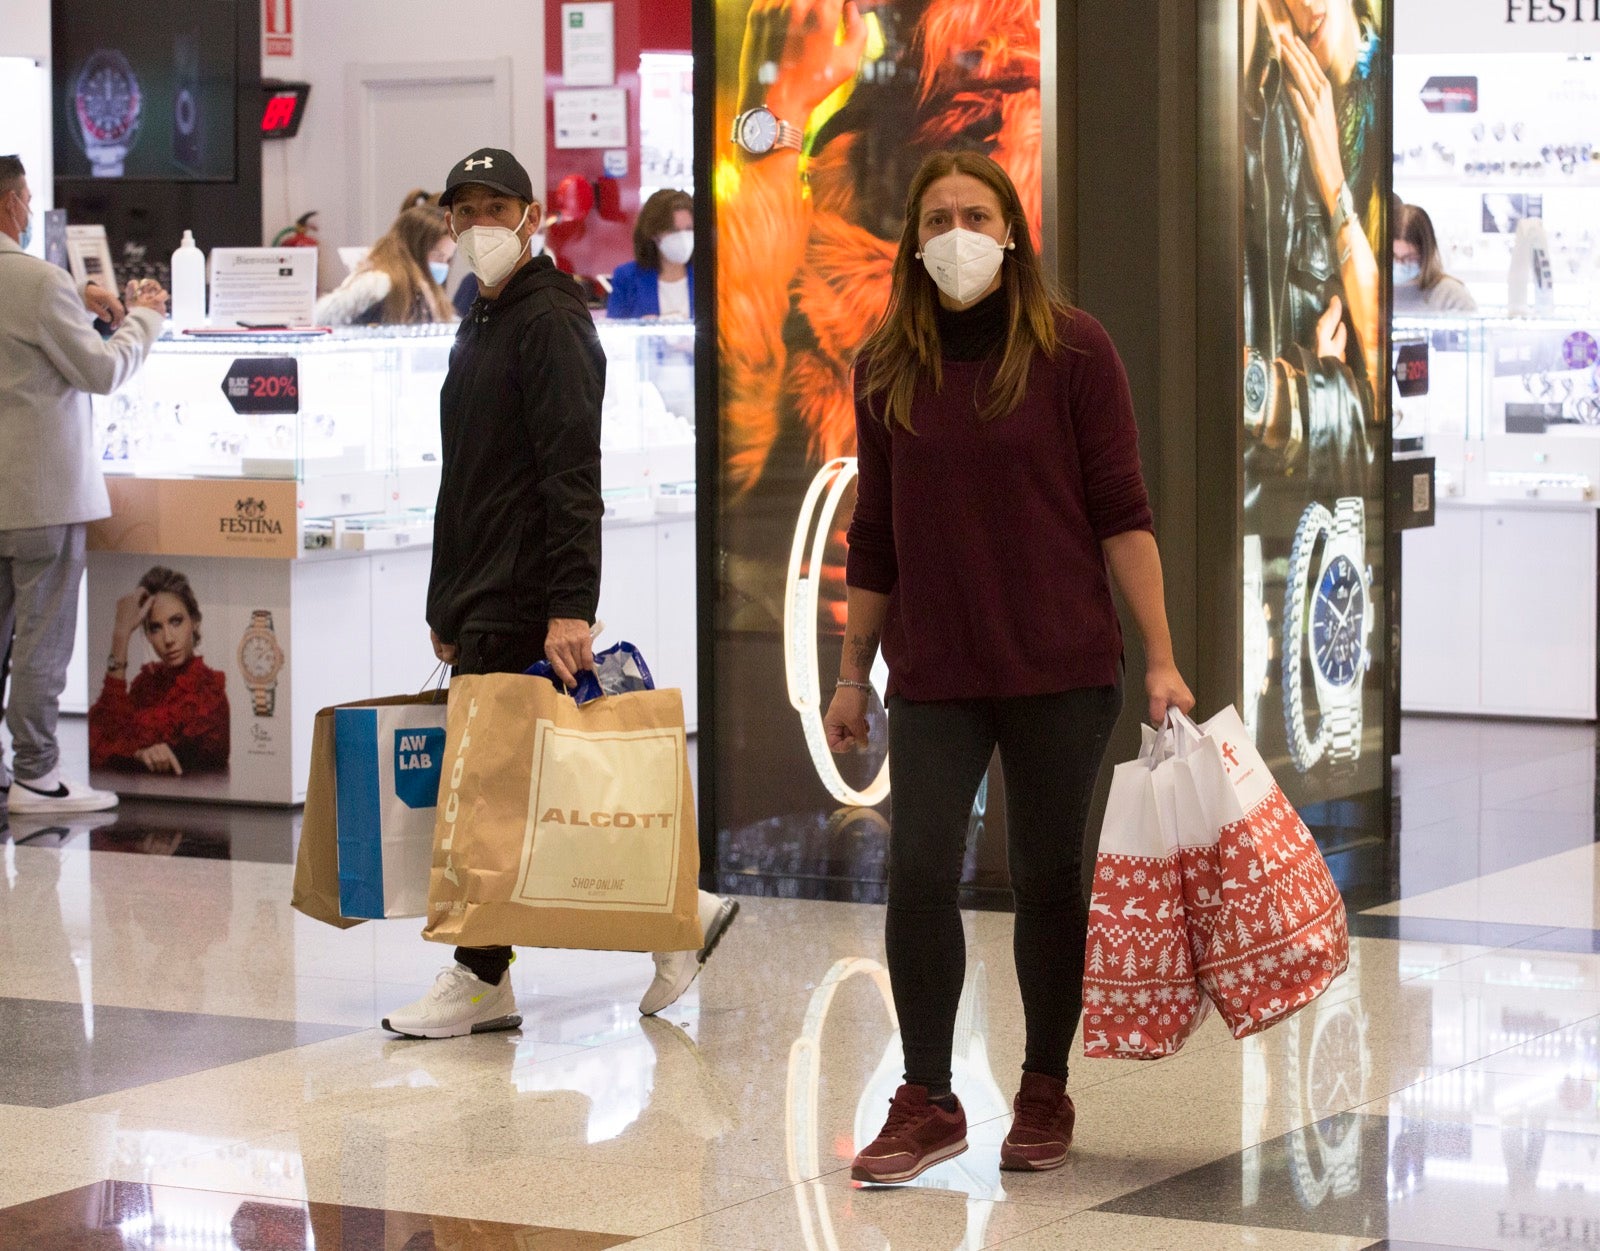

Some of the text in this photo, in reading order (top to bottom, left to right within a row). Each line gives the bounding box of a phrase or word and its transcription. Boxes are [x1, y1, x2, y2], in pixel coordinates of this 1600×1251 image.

[250, 375, 297, 398] -20%
[220, 518, 282, 534] FESTINA
[399, 735, 427, 752] AW
[399, 753, 432, 771] LAB
[441, 698, 477, 887] ALCOTT
[540, 807, 673, 829] ALCOTT
[571, 876, 625, 890] SHOP ONLINE
